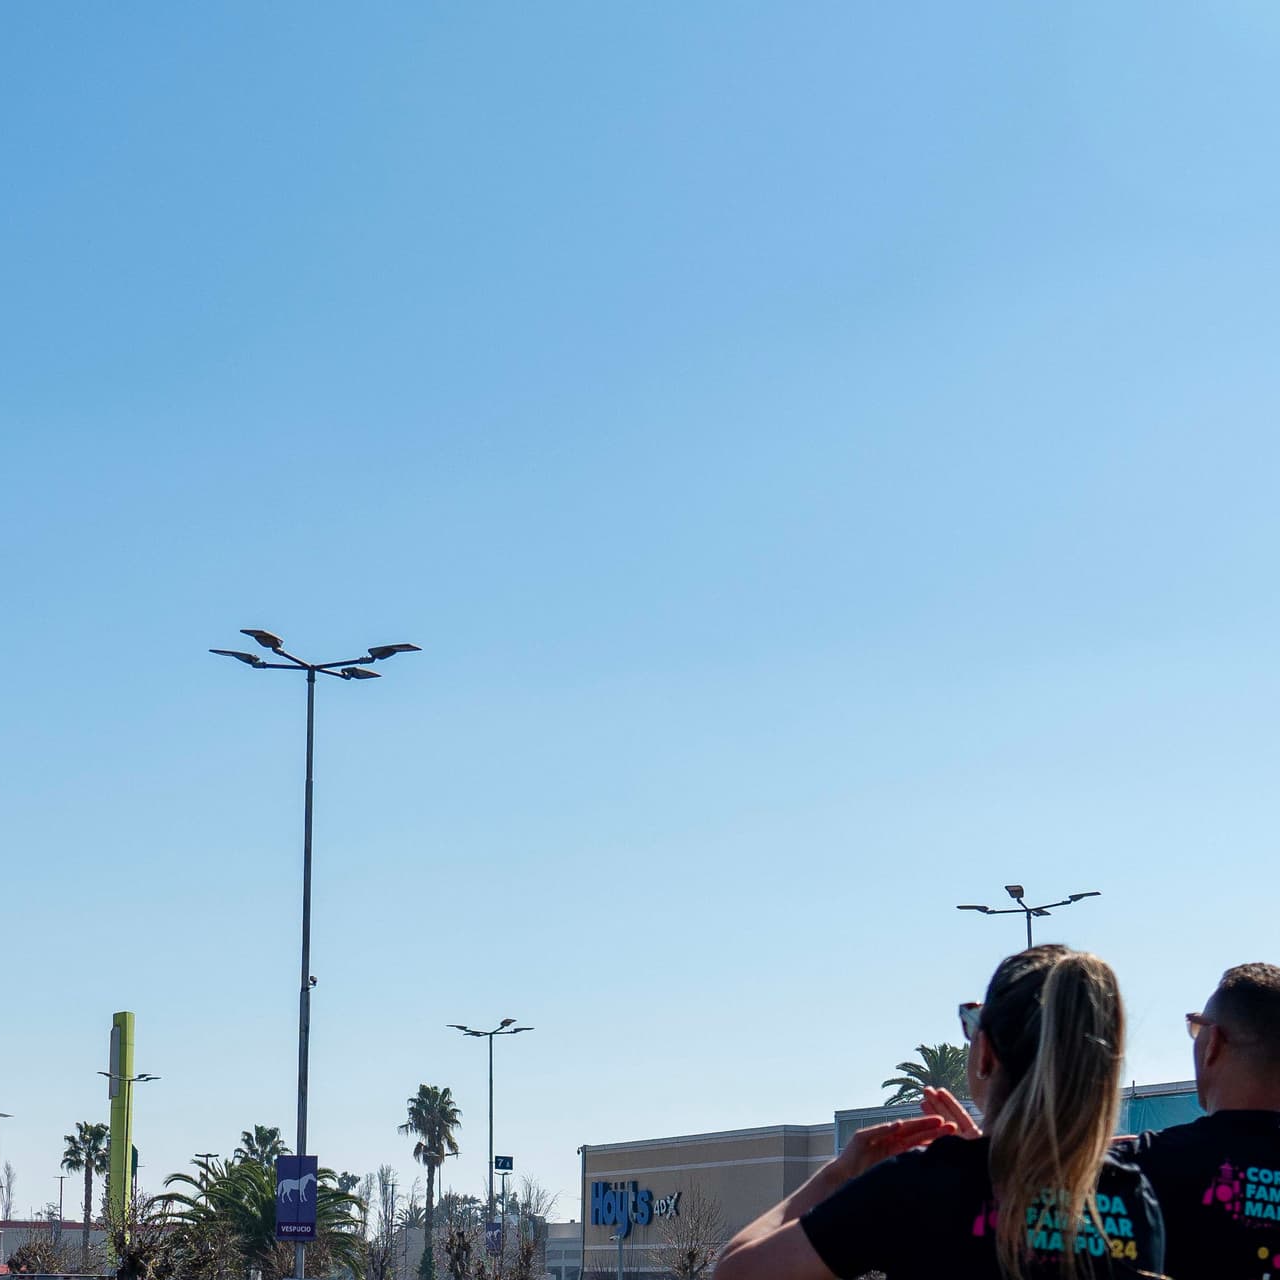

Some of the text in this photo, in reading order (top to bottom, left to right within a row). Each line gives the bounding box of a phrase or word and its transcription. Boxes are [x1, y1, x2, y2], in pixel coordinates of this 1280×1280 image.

[281, 1225, 312, 1233] VESPUCIO
[1026, 1229, 1138, 1260] MAPÚ 24
